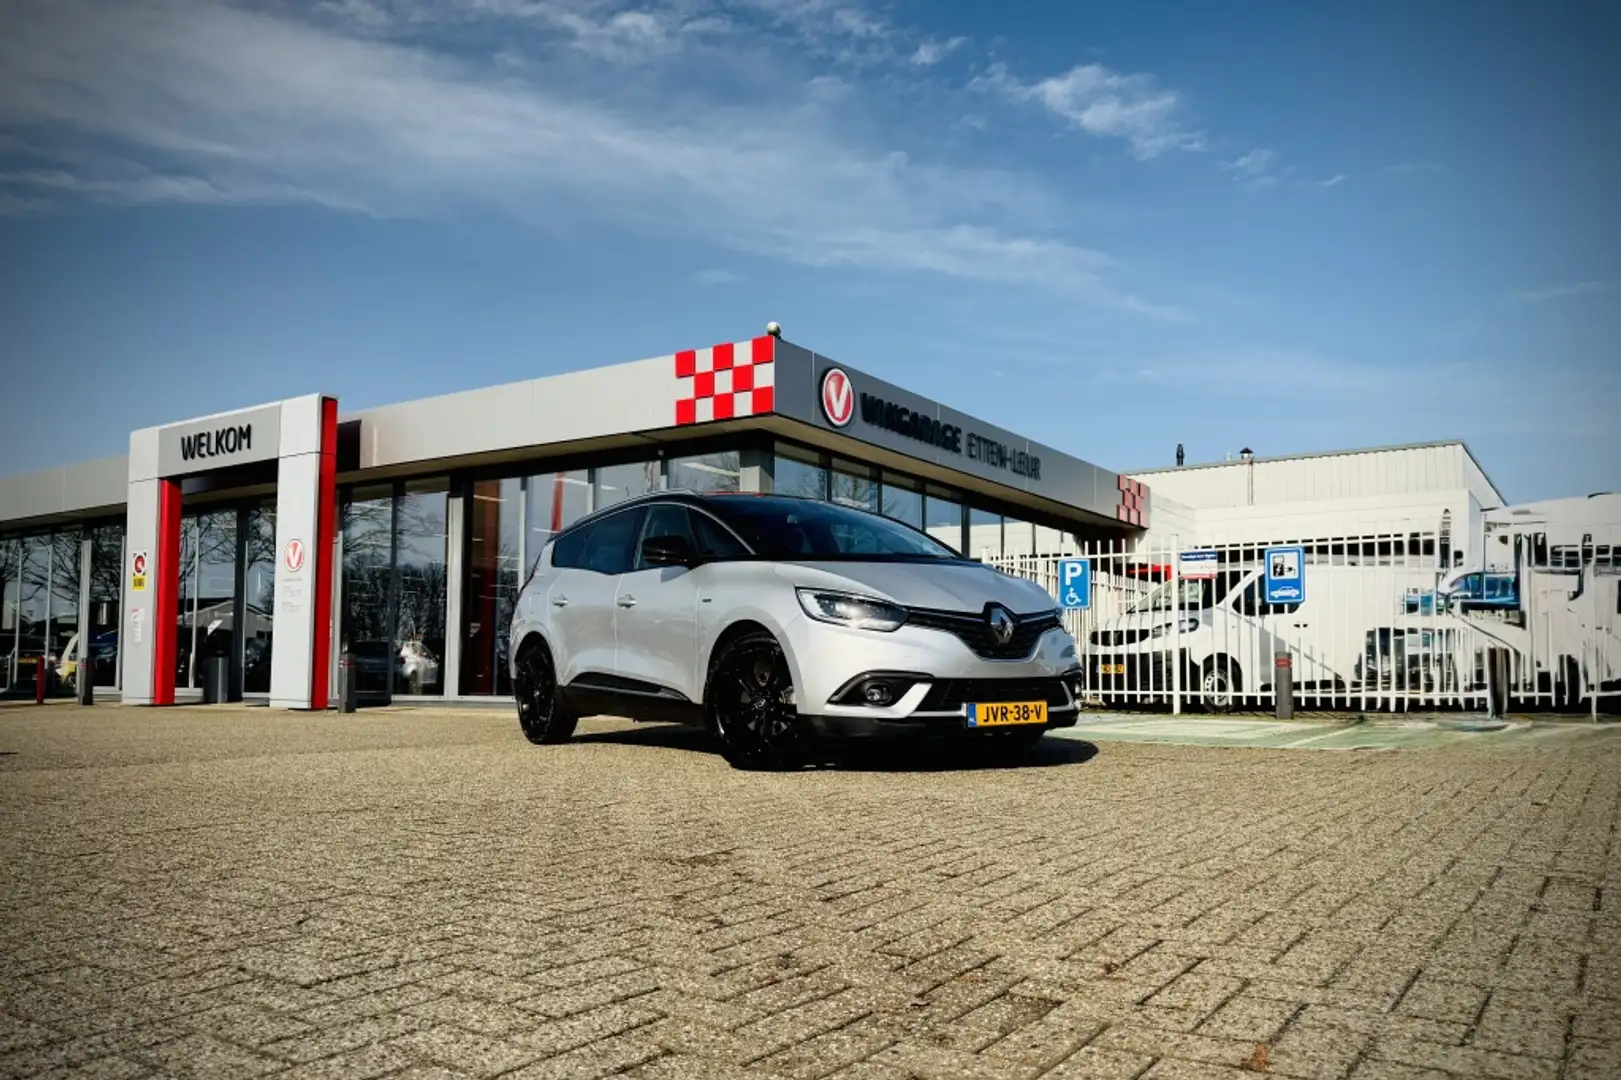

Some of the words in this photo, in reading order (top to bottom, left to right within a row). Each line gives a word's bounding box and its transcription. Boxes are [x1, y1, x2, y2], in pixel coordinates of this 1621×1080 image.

[181, 423, 252, 461] WELKOM
[1065, 562, 1082, 586] P
[983, 704, 1042, 723] JVR-38-V
